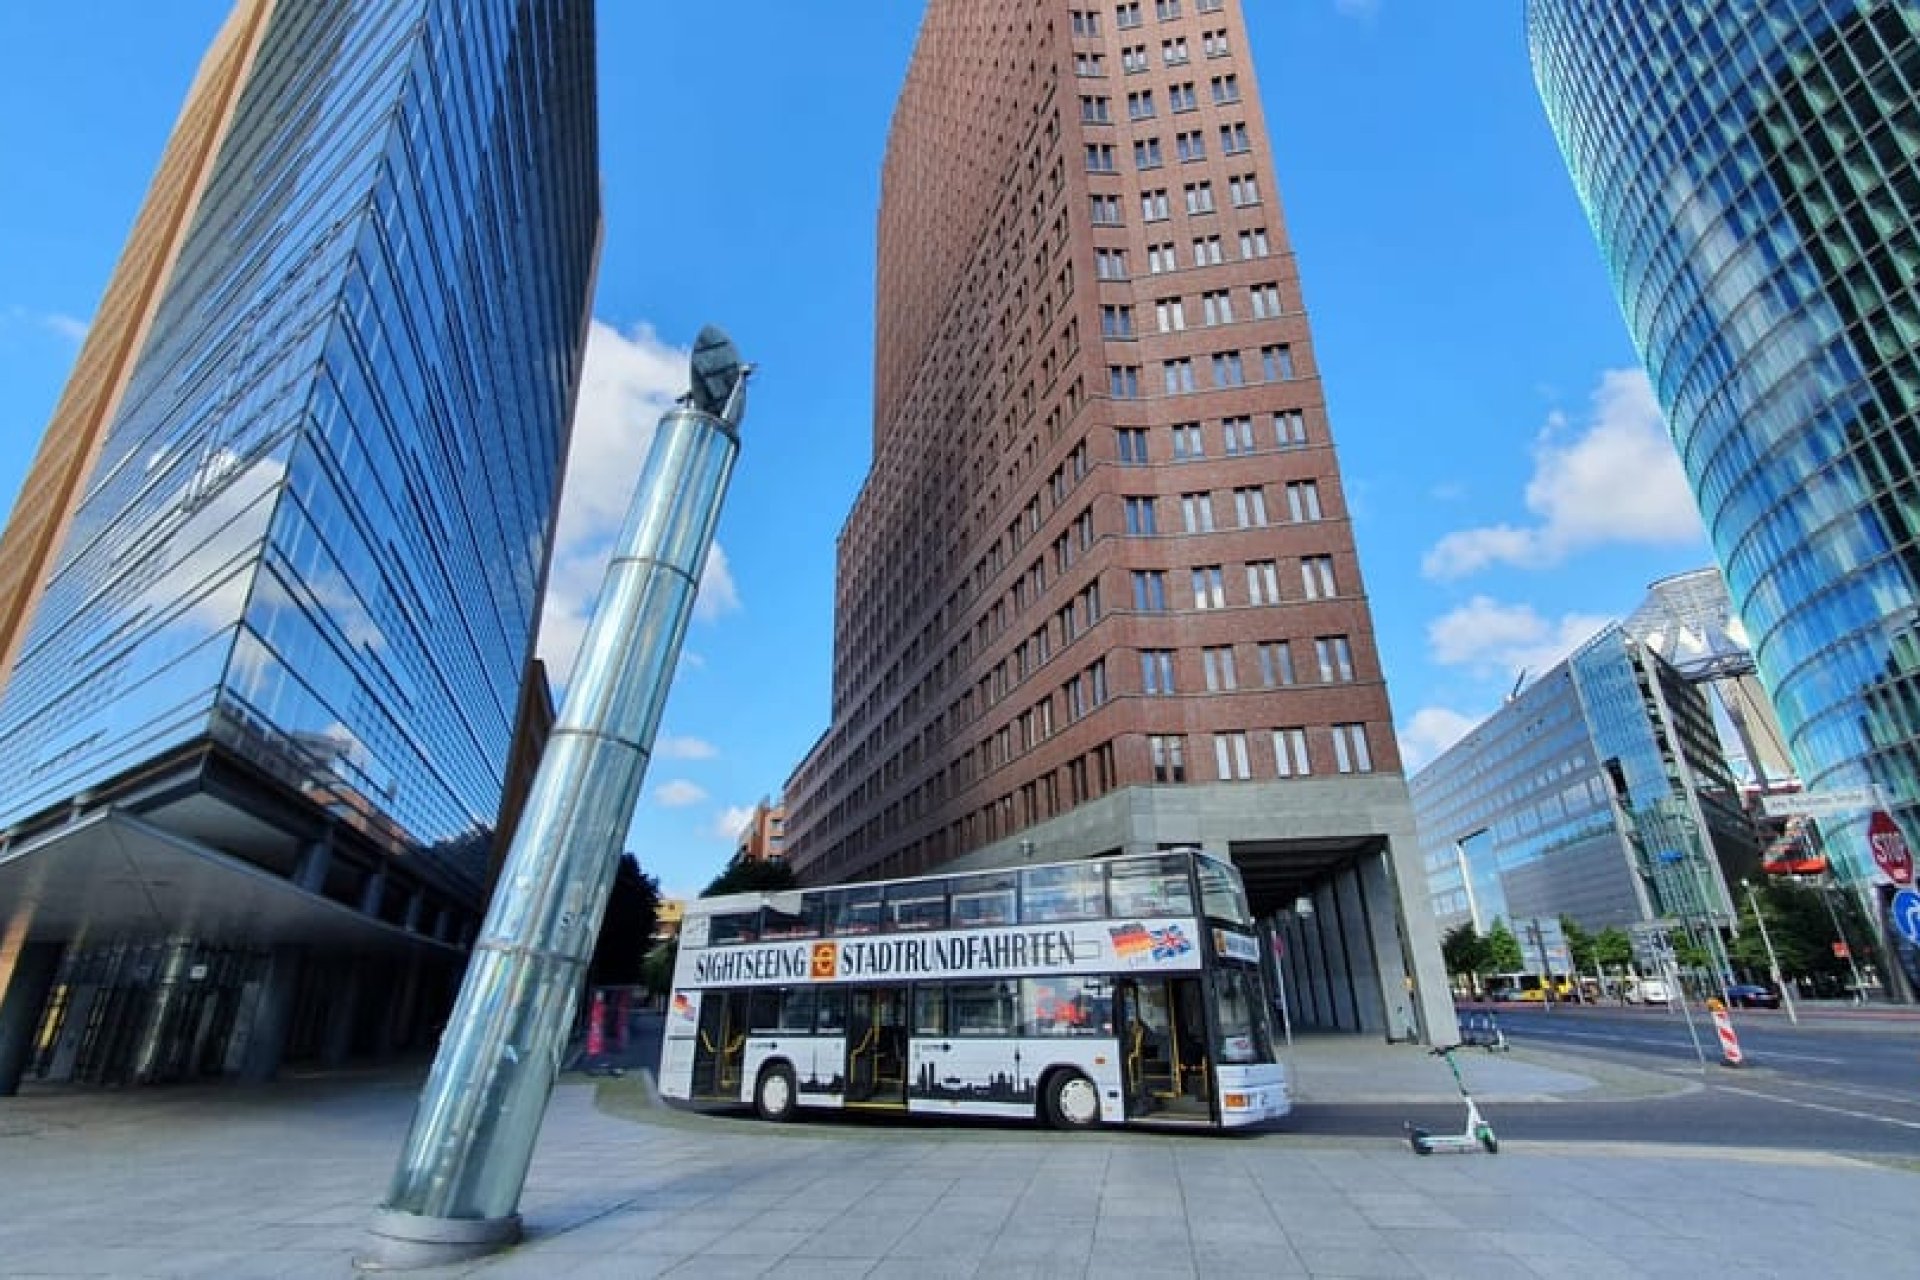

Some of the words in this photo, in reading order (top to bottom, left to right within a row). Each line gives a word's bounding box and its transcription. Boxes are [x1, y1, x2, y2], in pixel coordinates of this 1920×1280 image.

[1872, 832, 1907, 863] STOP
[695, 948, 806, 984] SIGHTSEEING
[843, 930, 1075, 976] STADTRUNDFAHRTEN
